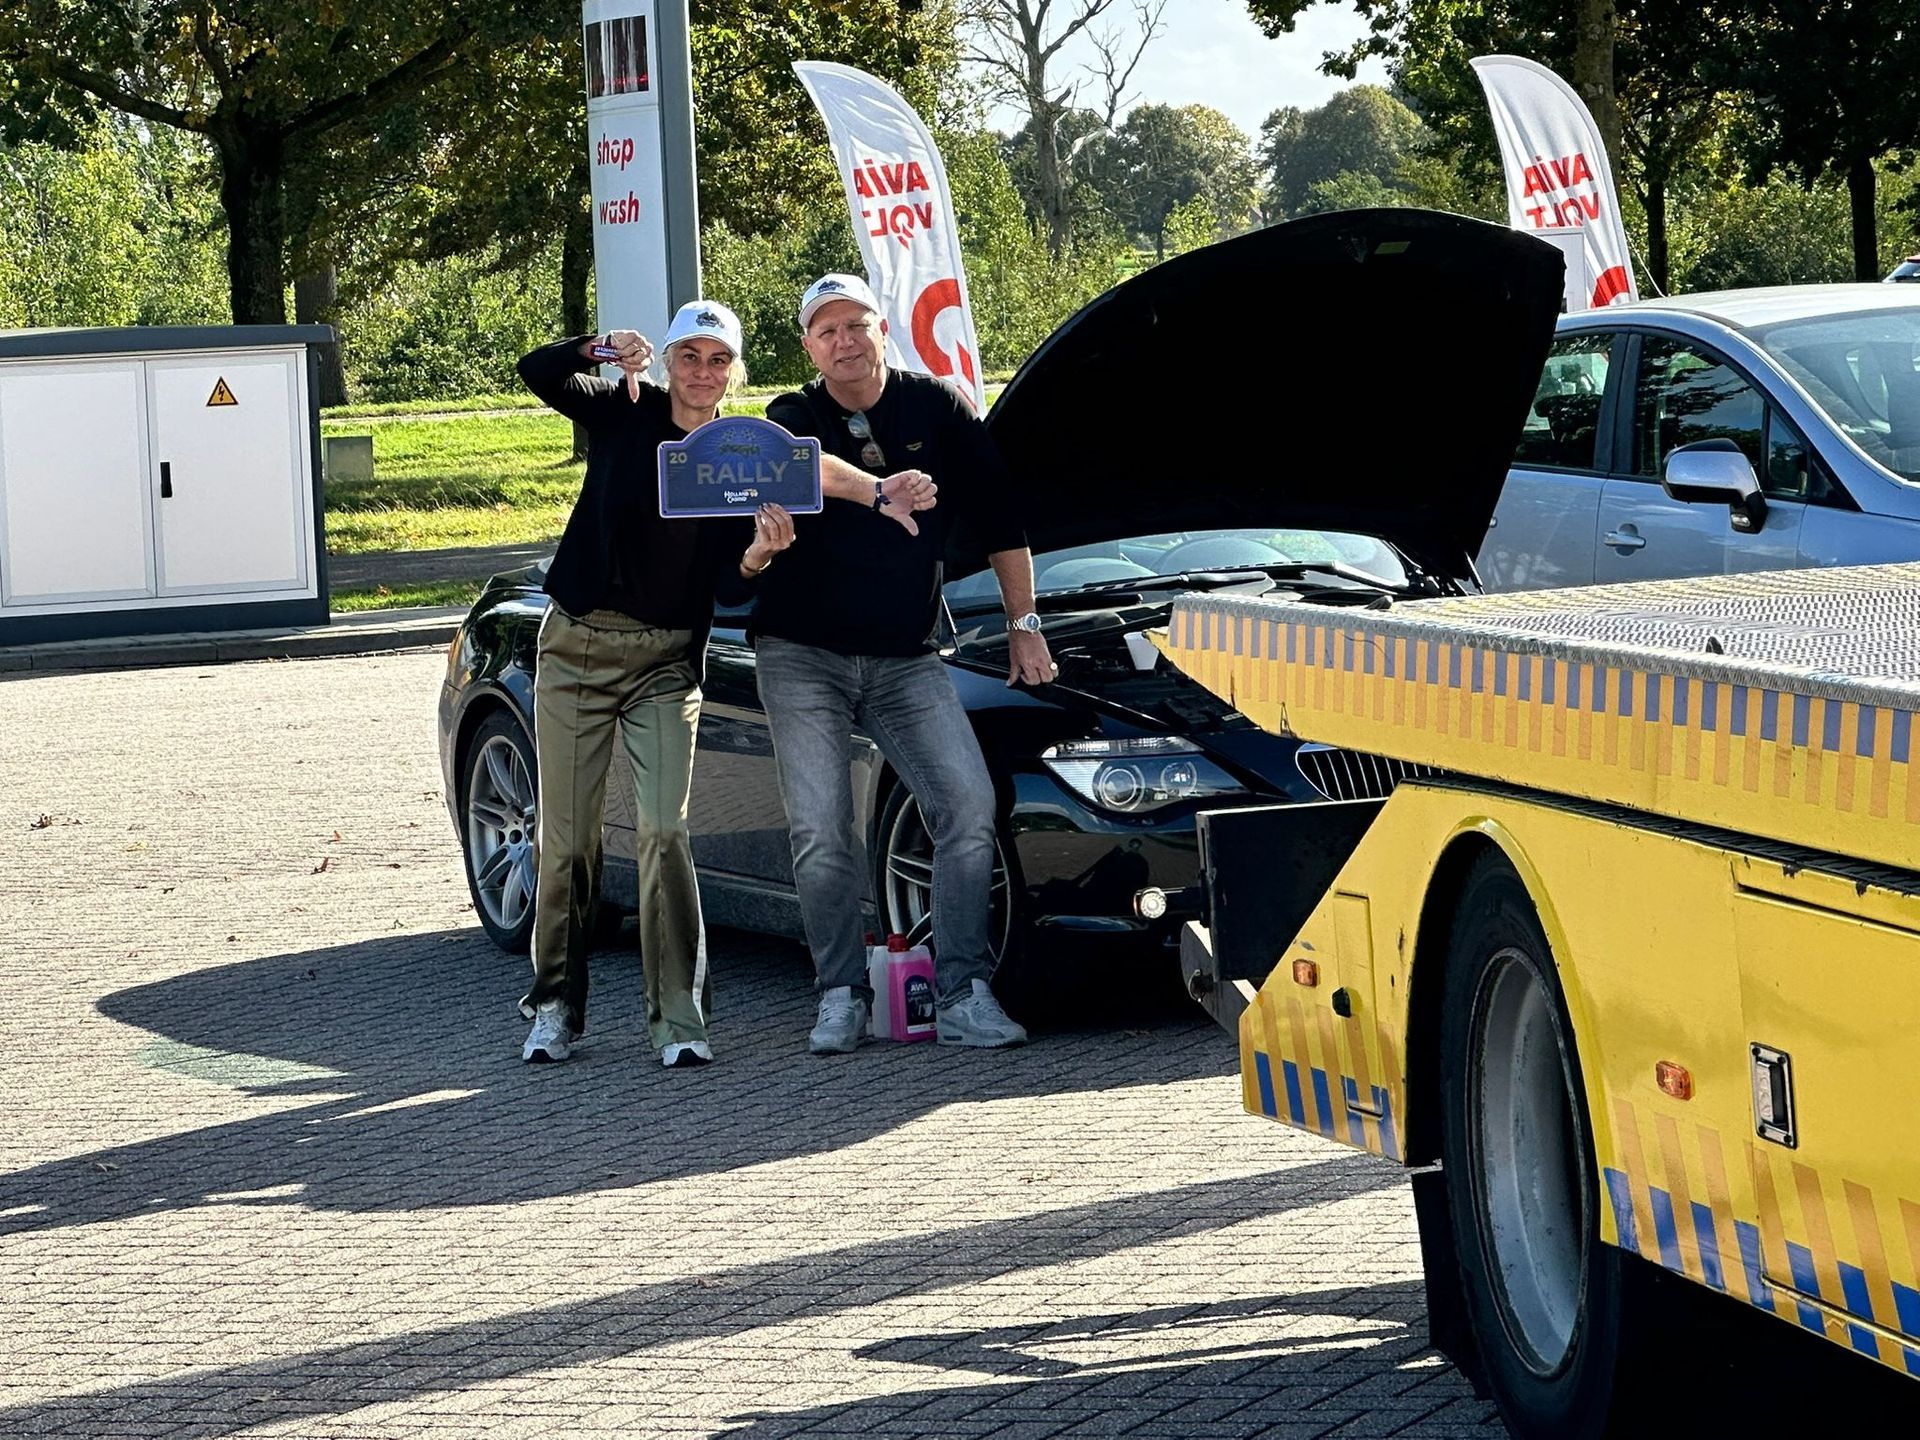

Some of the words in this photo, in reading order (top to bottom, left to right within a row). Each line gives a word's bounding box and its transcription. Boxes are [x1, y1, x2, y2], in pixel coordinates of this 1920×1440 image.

[597, 133, 634, 171] shop
[600, 191, 639, 225] wash
[669, 452, 687, 464] 20
[793, 449, 810, 460] 25
[696, 460, 789, 485] RALLY
[910, 982, 928, 992] AVIA
